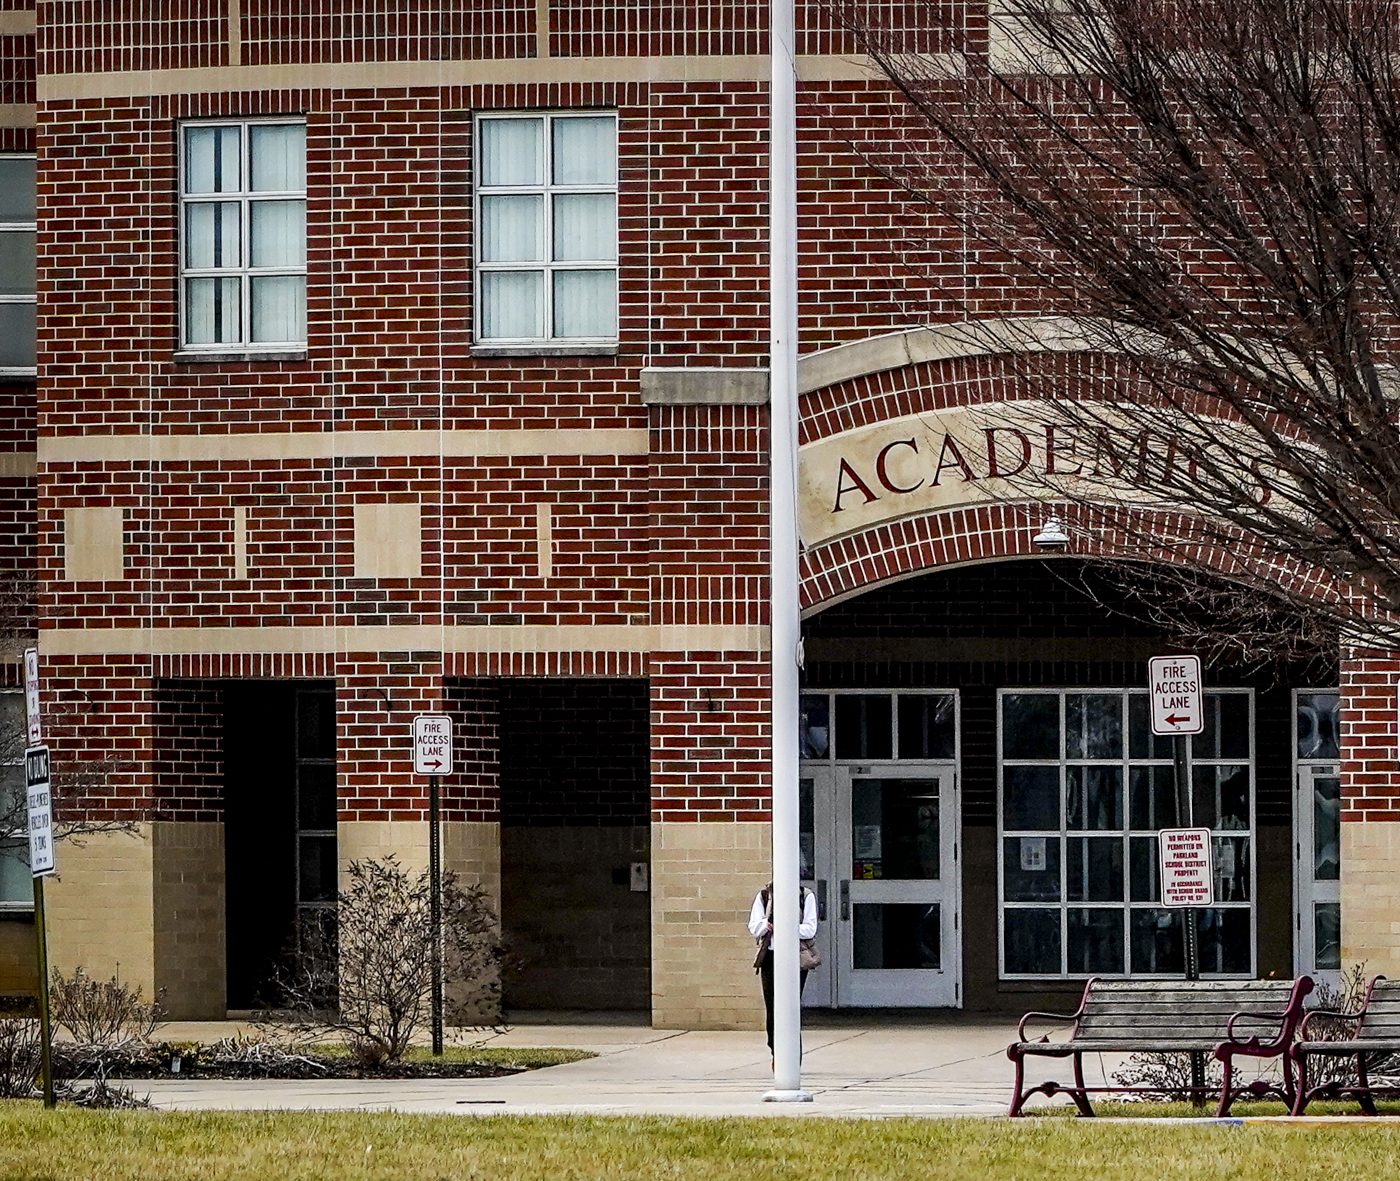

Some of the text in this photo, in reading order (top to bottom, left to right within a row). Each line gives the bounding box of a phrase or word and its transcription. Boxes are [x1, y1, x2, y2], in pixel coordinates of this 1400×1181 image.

[1163, 666, 1186, 678] FIRE
[1155, 681, 1196, 694] ACCESS
[1162, 696, 1190, 709] LANE
[424, 723, 441, 733] FIRE
[418, 735, 449, 744] ACCESS
[422, 747, 443, 756] LANE
